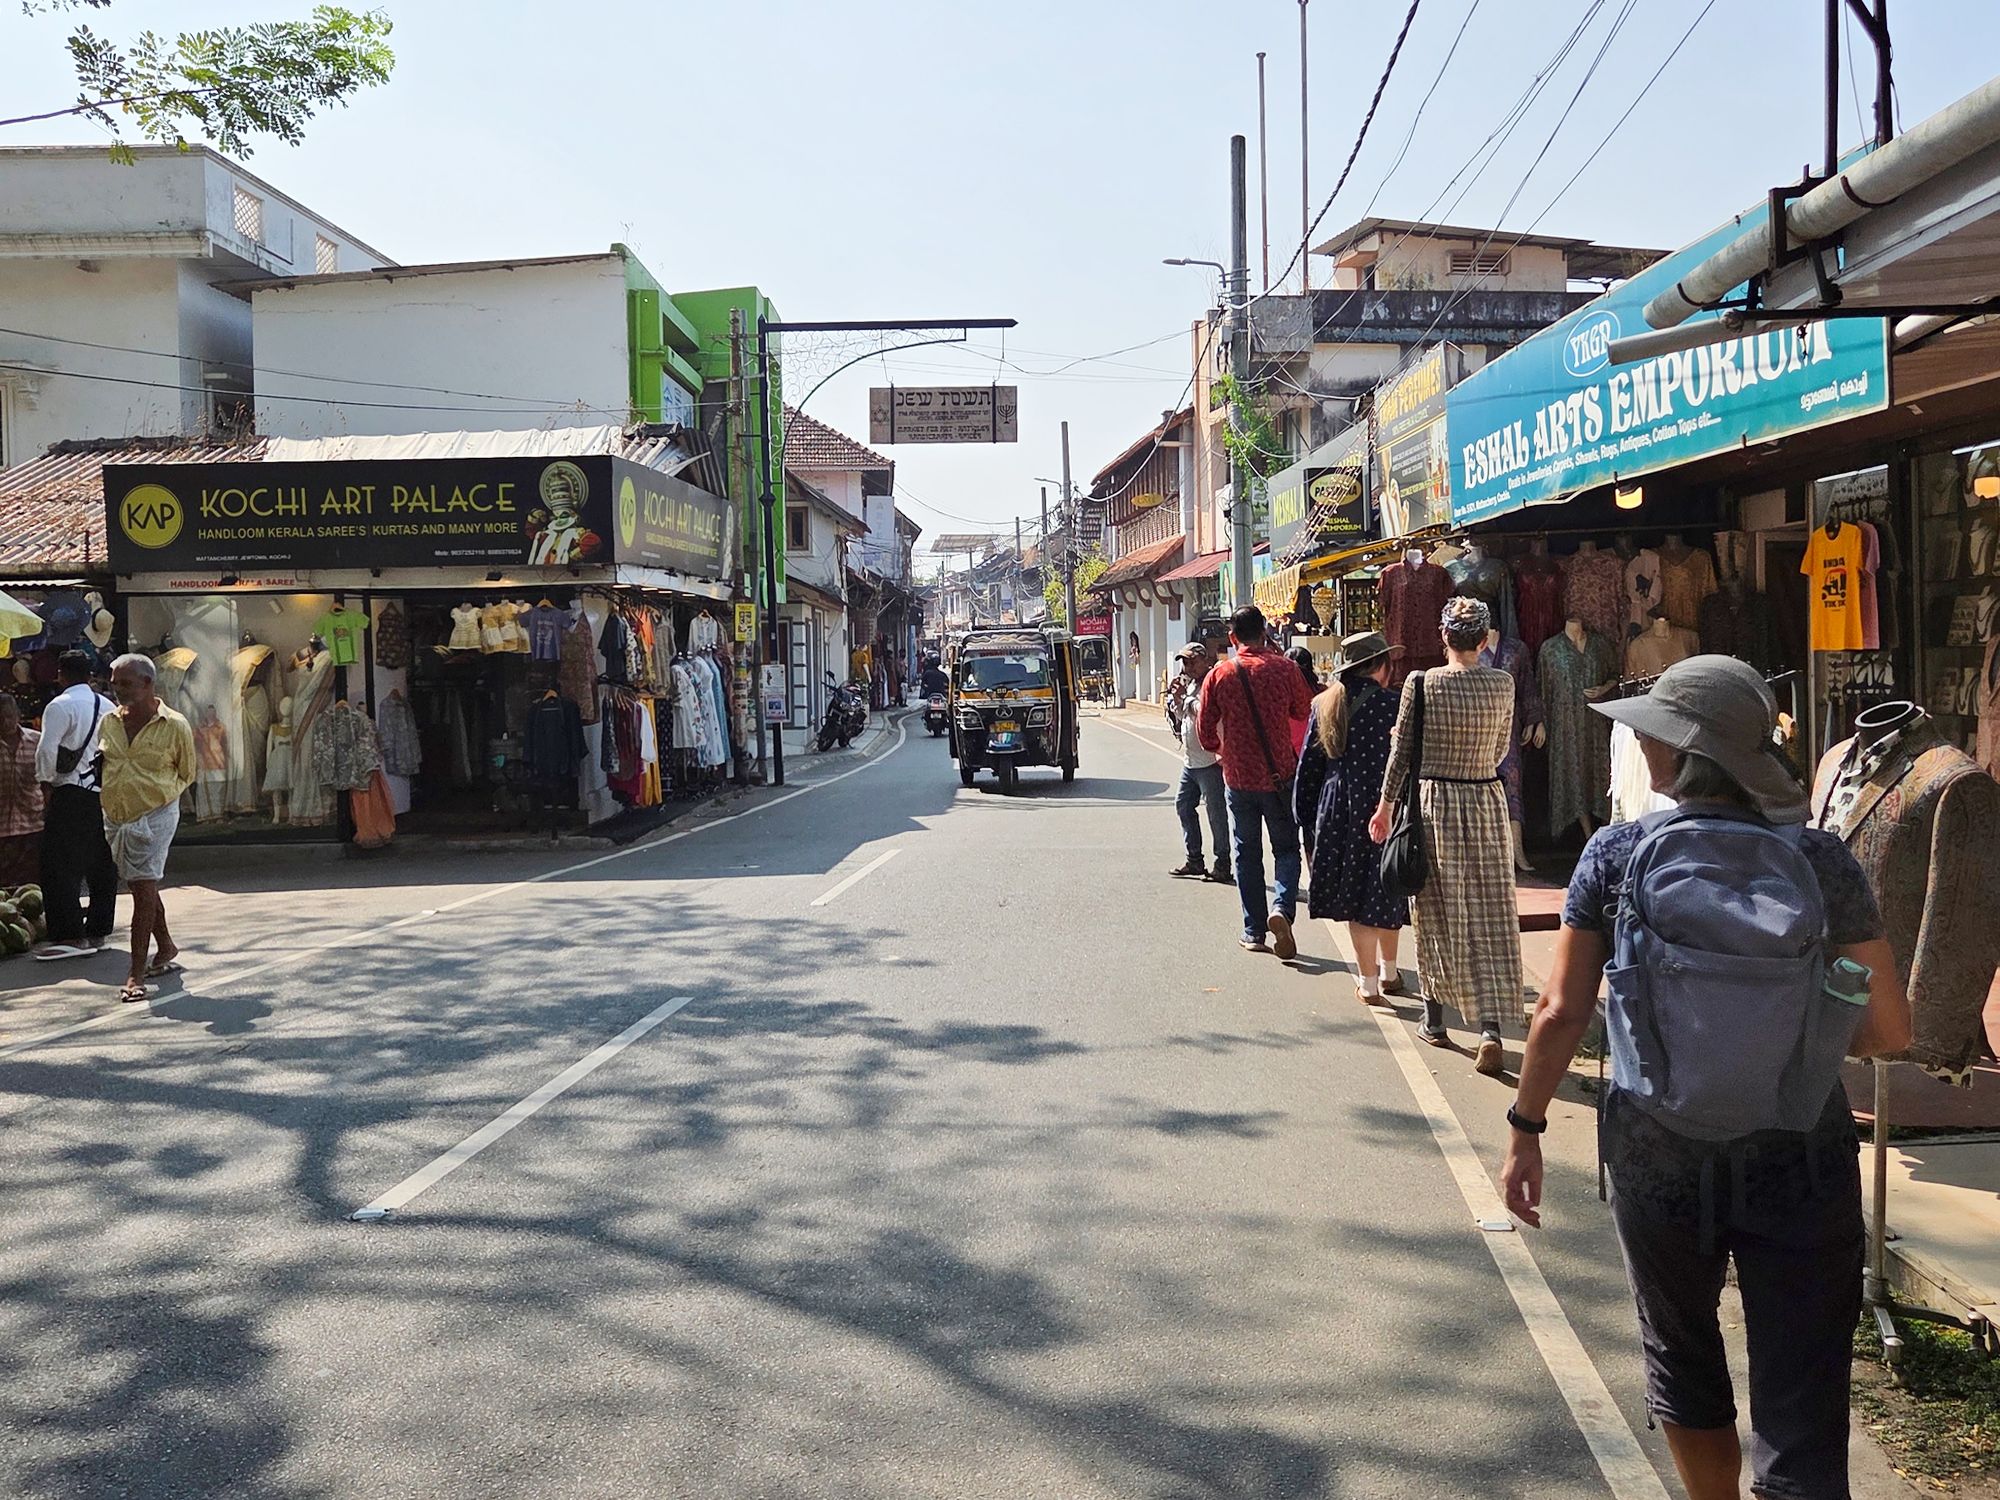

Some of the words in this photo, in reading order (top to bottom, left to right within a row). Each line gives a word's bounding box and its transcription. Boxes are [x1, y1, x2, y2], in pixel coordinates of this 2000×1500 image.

[896, 391, 933, 406] JEW
[938, 391, 991, 406] TOWN
[1463, 419, 1528, 490] ESHAL
[1533, 385, 1601, 459] ARTS
[1608, 319, 1833, 434] EMPORIUM
[1619, 432, 1652, 453] Antiques,
[1652, 424, 1678, 443] Cotton
[1677, 417, 1697, 437] Tops
[126, 502, 175, 530] KAP
[200, 487, 307, 518] KOCHI
[320, 486, 376, 516] ART
[391, 484, 516, 514] PALACE
[644, 489, 675, 531] KOCHI
[676, 503, 692, 535] ART
[693, 507, 721, 543] PALACE
[198, 527, 265, 540] HANDLOOM
[268, 526, 315, 538] KERALA
[317, 525, 367, 537] SAREE'S
[372, 523, 419, 536] KURTAS
[421, 523, 445, 535] AND
[448, 522, 481, 534] MANY
[484, 522, 518, 533] MORE
[266, 578, 295, 586] SAREE
